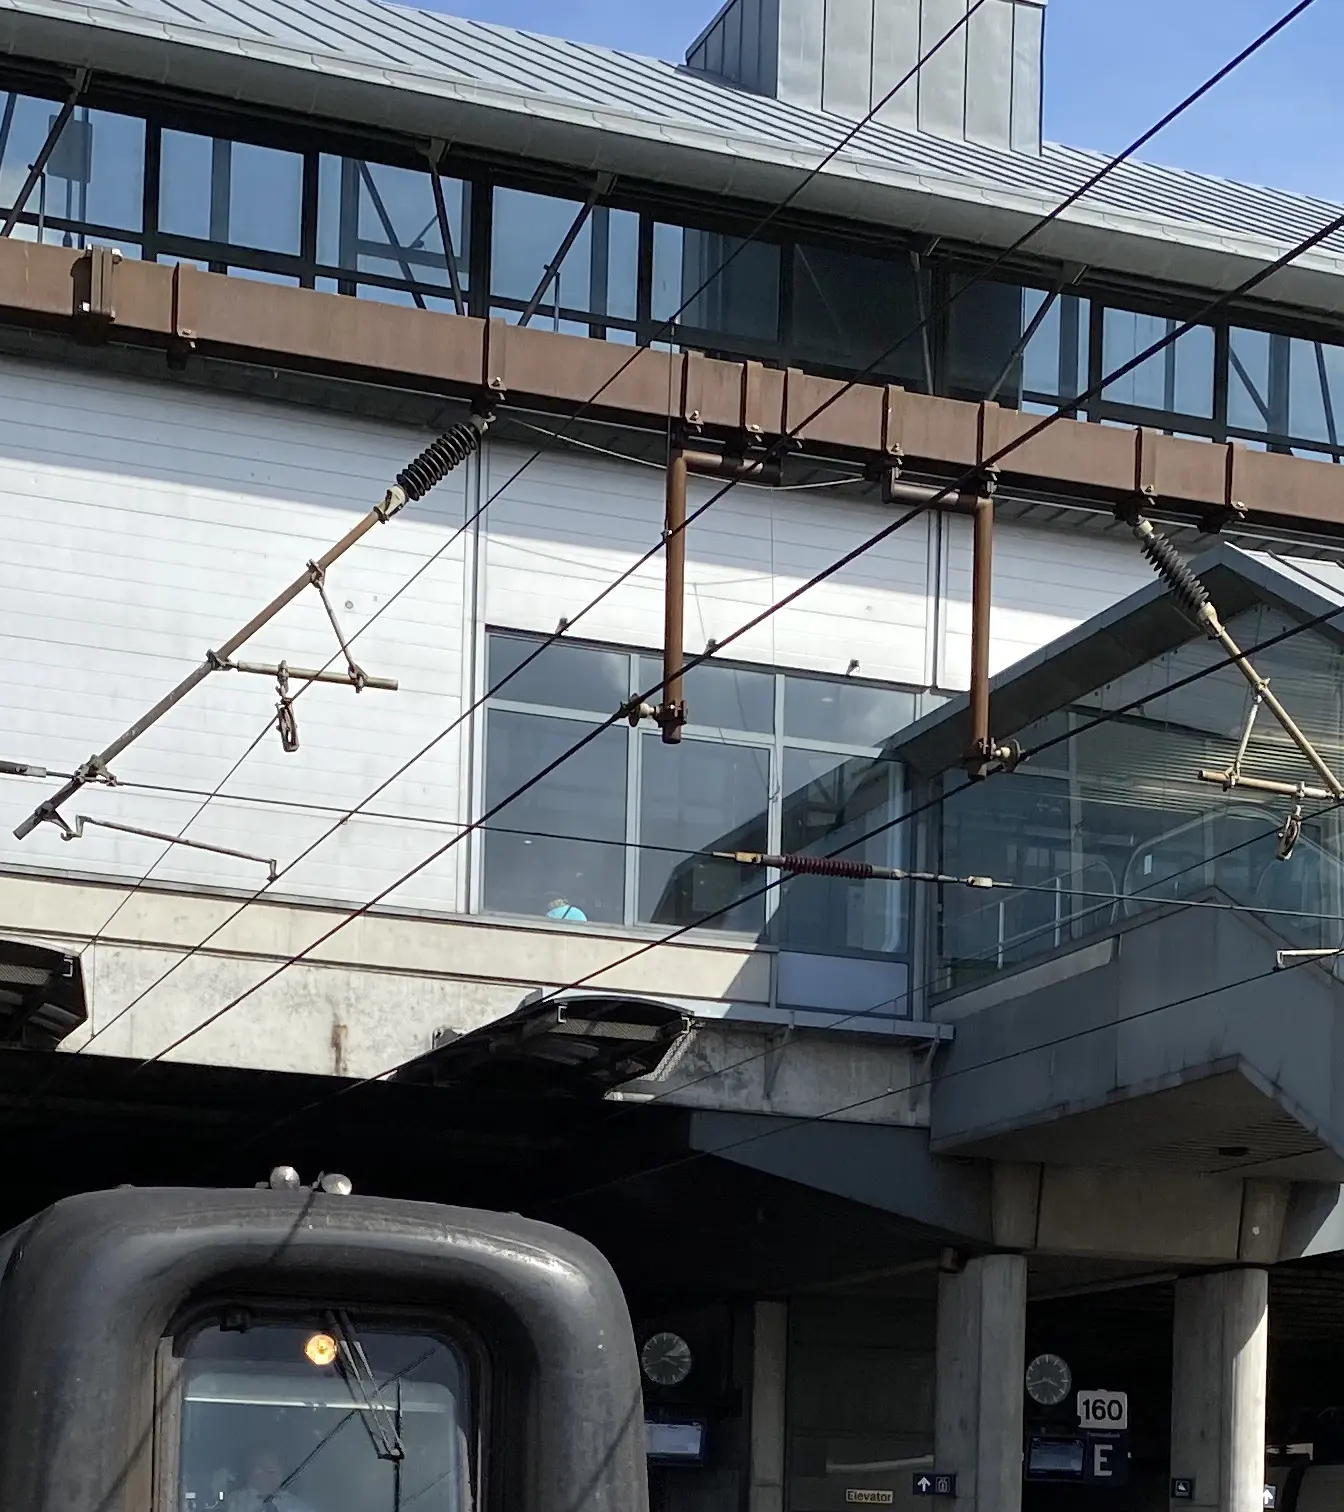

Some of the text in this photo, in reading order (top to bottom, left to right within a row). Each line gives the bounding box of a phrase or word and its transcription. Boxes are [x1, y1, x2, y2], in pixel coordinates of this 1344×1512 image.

[1082, 1398, 1123, 1421] 160
[1094, 1444, 1113, 1476] E
[847, 1490, 892, 1502] Elevator
